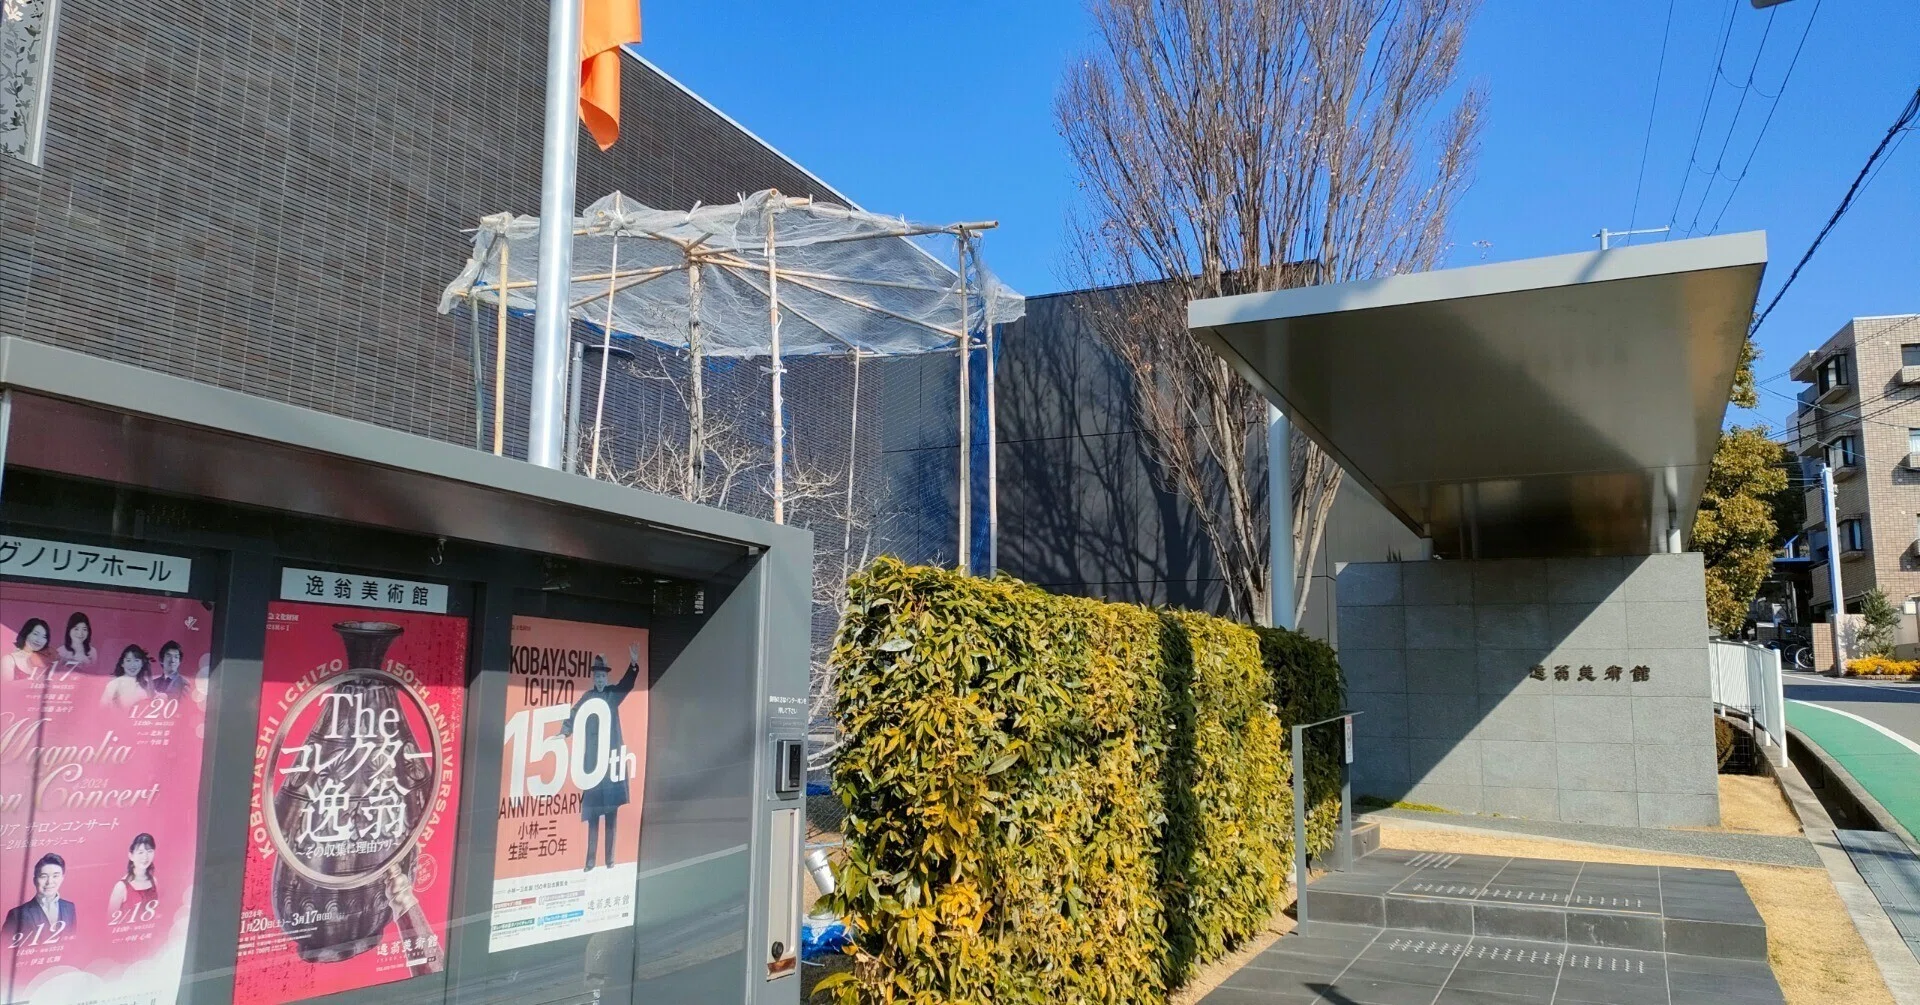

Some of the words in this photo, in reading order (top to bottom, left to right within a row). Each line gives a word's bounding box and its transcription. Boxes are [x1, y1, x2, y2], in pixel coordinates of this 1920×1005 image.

[0, 541, 172, 582] グノリアホール
[304, 574, 429, 607] 逸翁美術館
[510, 645, 593, 678] KOBAYASHI
[1528, 664, 1651, 682] 逸翁美術館
[523, 677, 575, 706] ICHIZO
[128, 698, 179, 719] 1/20
[317, 692, 401, 740] The
[250, 715, 281, 860] KOBAYASHI
[277, 657, 344, 712] ICHIZO
[385, 659, 431, 701] 150TH
[416, 702, 453, 854] ANNIVERSARY
[278, 737, 433, 782] コレクター
[35, 763, 160, 812] Concert
[297, 778, 413, 845] 逸翁
[498, 793, 585, 820] ANNIVERSARY
[517, 819, 558, 841] 小林一三
[108, 899, 160, 926] 2/18
[8, 920, 67, 949] 2/12
[377, 934, 439, 956] 逸翁美術館
